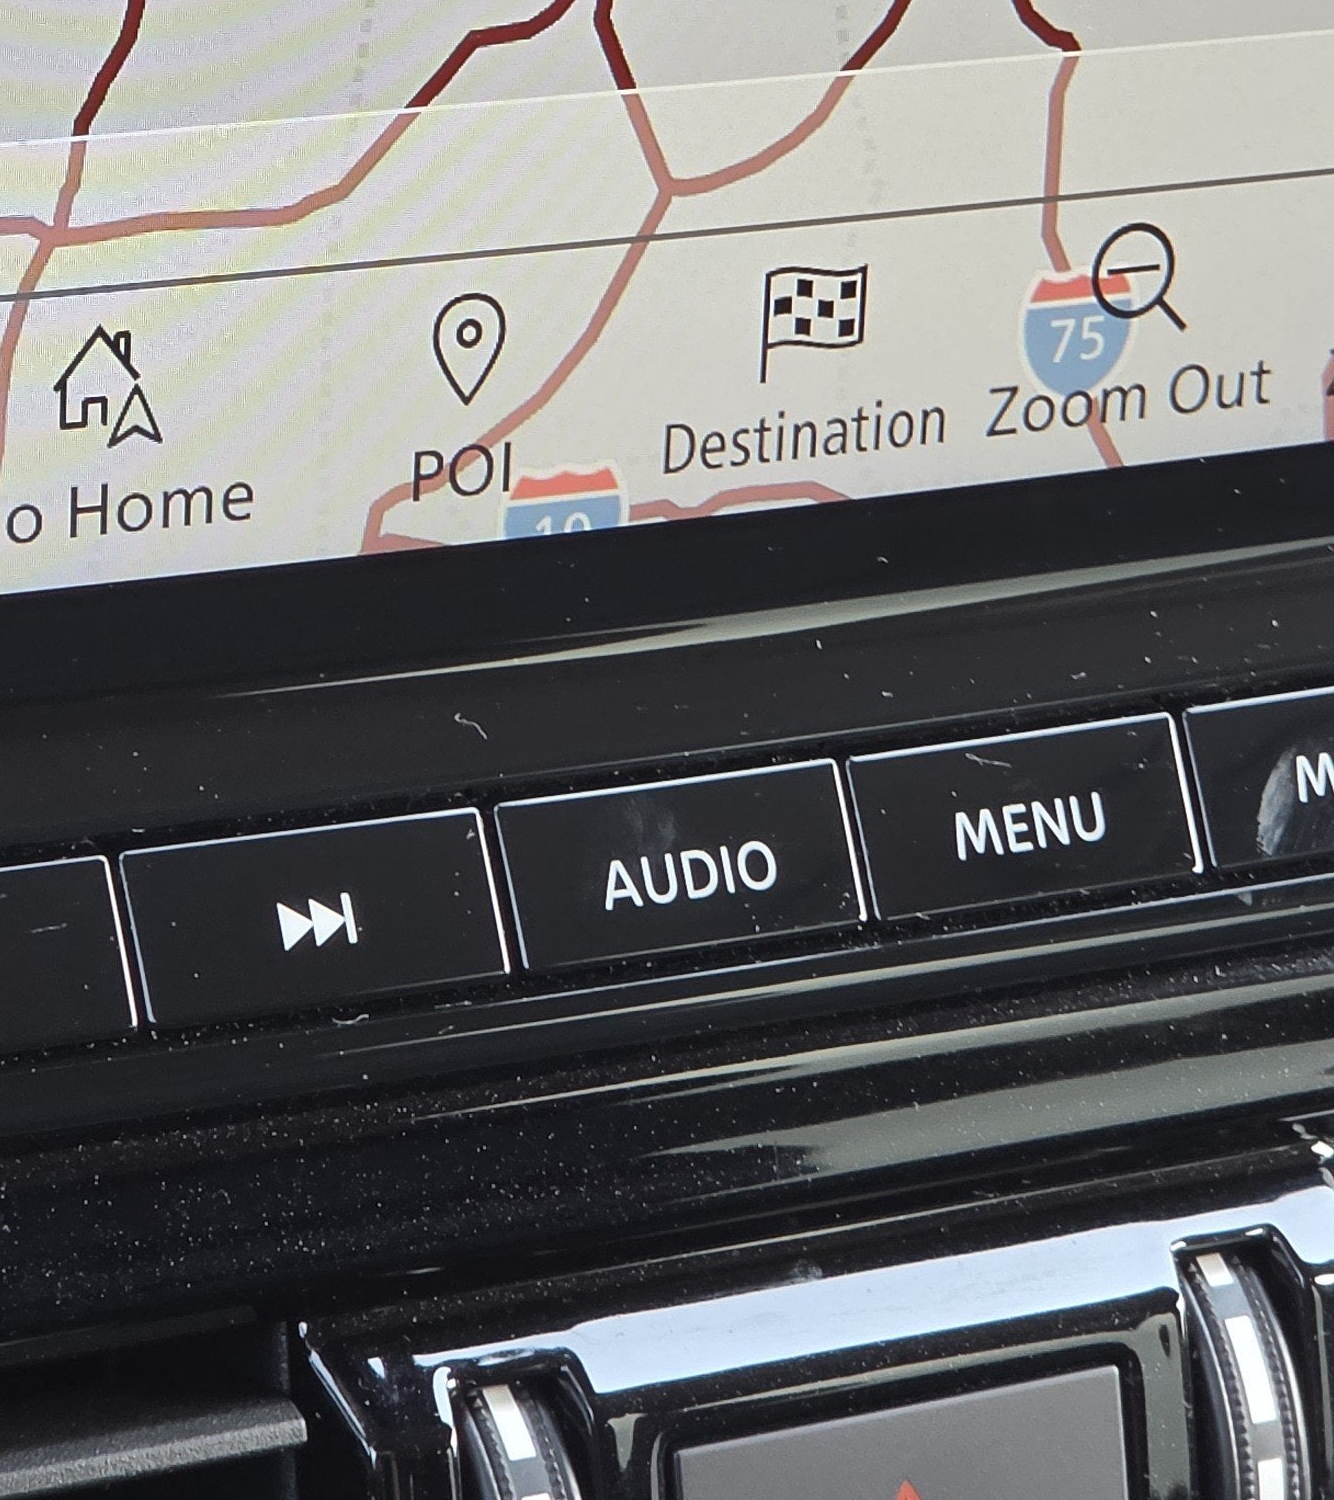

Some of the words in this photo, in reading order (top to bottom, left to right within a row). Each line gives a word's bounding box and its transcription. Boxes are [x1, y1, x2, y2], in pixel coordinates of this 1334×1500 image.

[1048, 314, 1106, 364] 75
[985, 380, 1148, 438] Zoom
[1169, 358, 1273, 415] Out
[412, 442, 513, 502] POI
[662, 399, 947, 476] Destination
[68, 479, 255, 539] Home
[953, 790, 1108, 862] MENU
[603, 838, 779, 912] AUDIO
